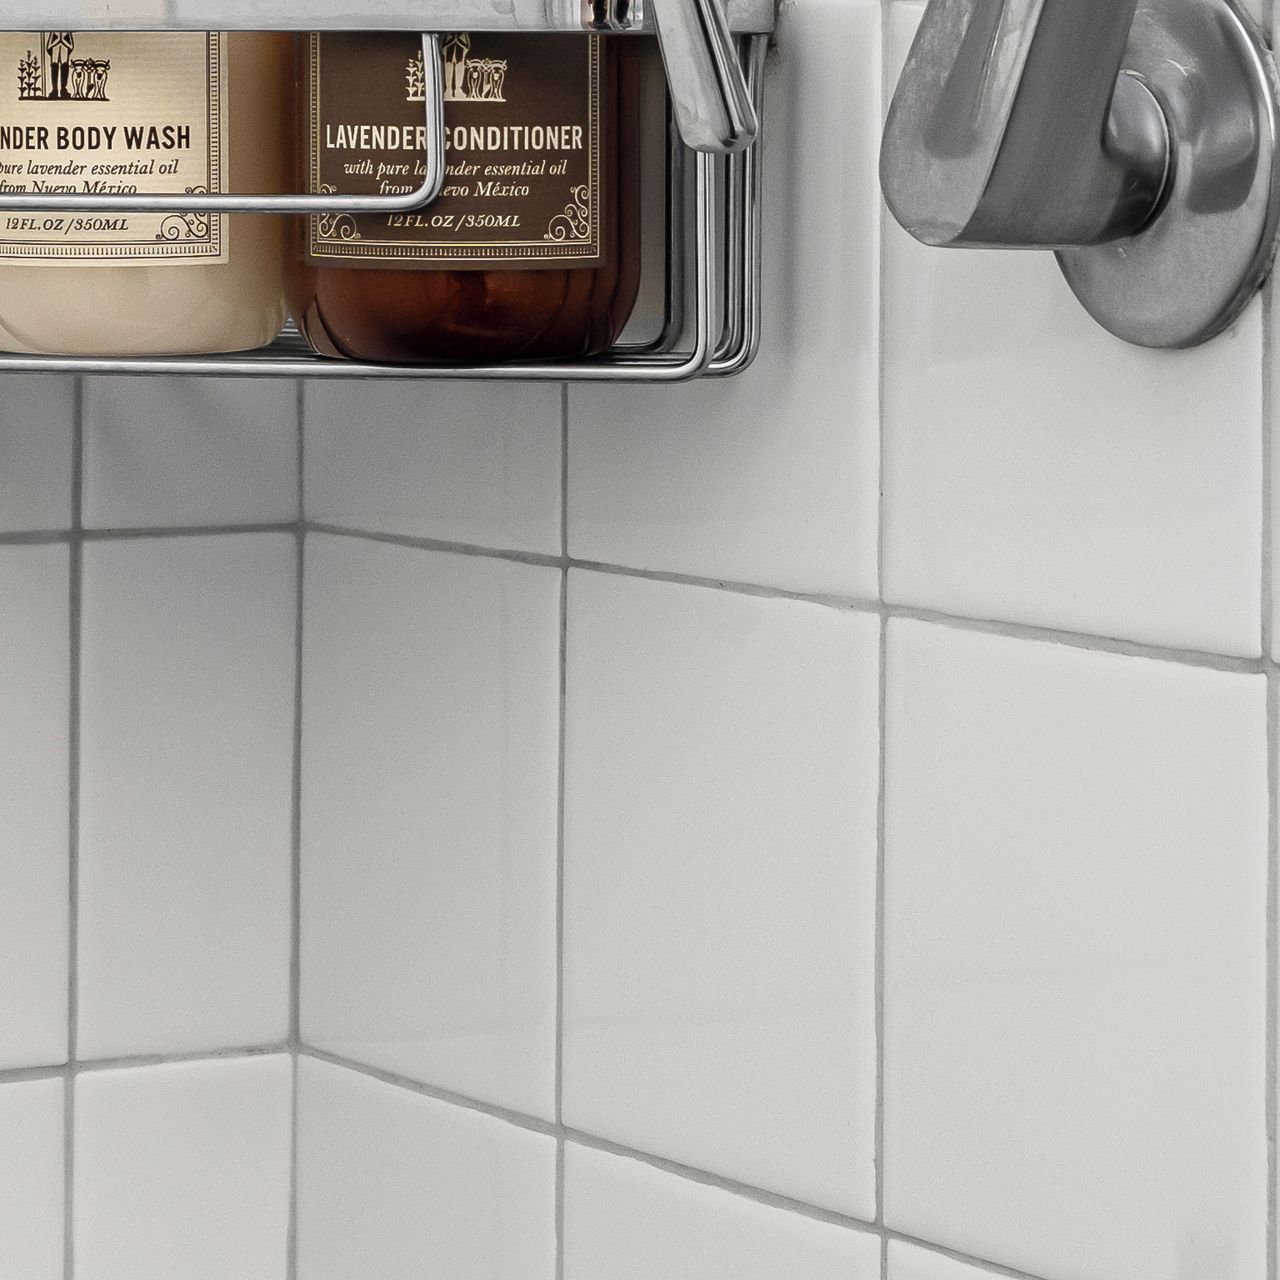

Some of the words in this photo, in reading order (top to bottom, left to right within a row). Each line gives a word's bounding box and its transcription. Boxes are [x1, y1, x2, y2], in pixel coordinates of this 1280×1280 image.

[57, 126, 117, 150] BODY
[124, 125, 190, 150] WASH
[326, 125, 427, 150] LAVENDER
[26, 160, 87, 176] lavender
[91, 159, 154, 175] essential
[158, 159, 179, 174] oil
[343, 159, 374, 175] with
[375, 162, 410, 180] pure
[413, 160, 480, 176] lander
[484, 160, 546, 176] essential
[549, 160, 568, 175] oil
[379, 180, 413, 195] from
[473, 181, 530, 197] México
